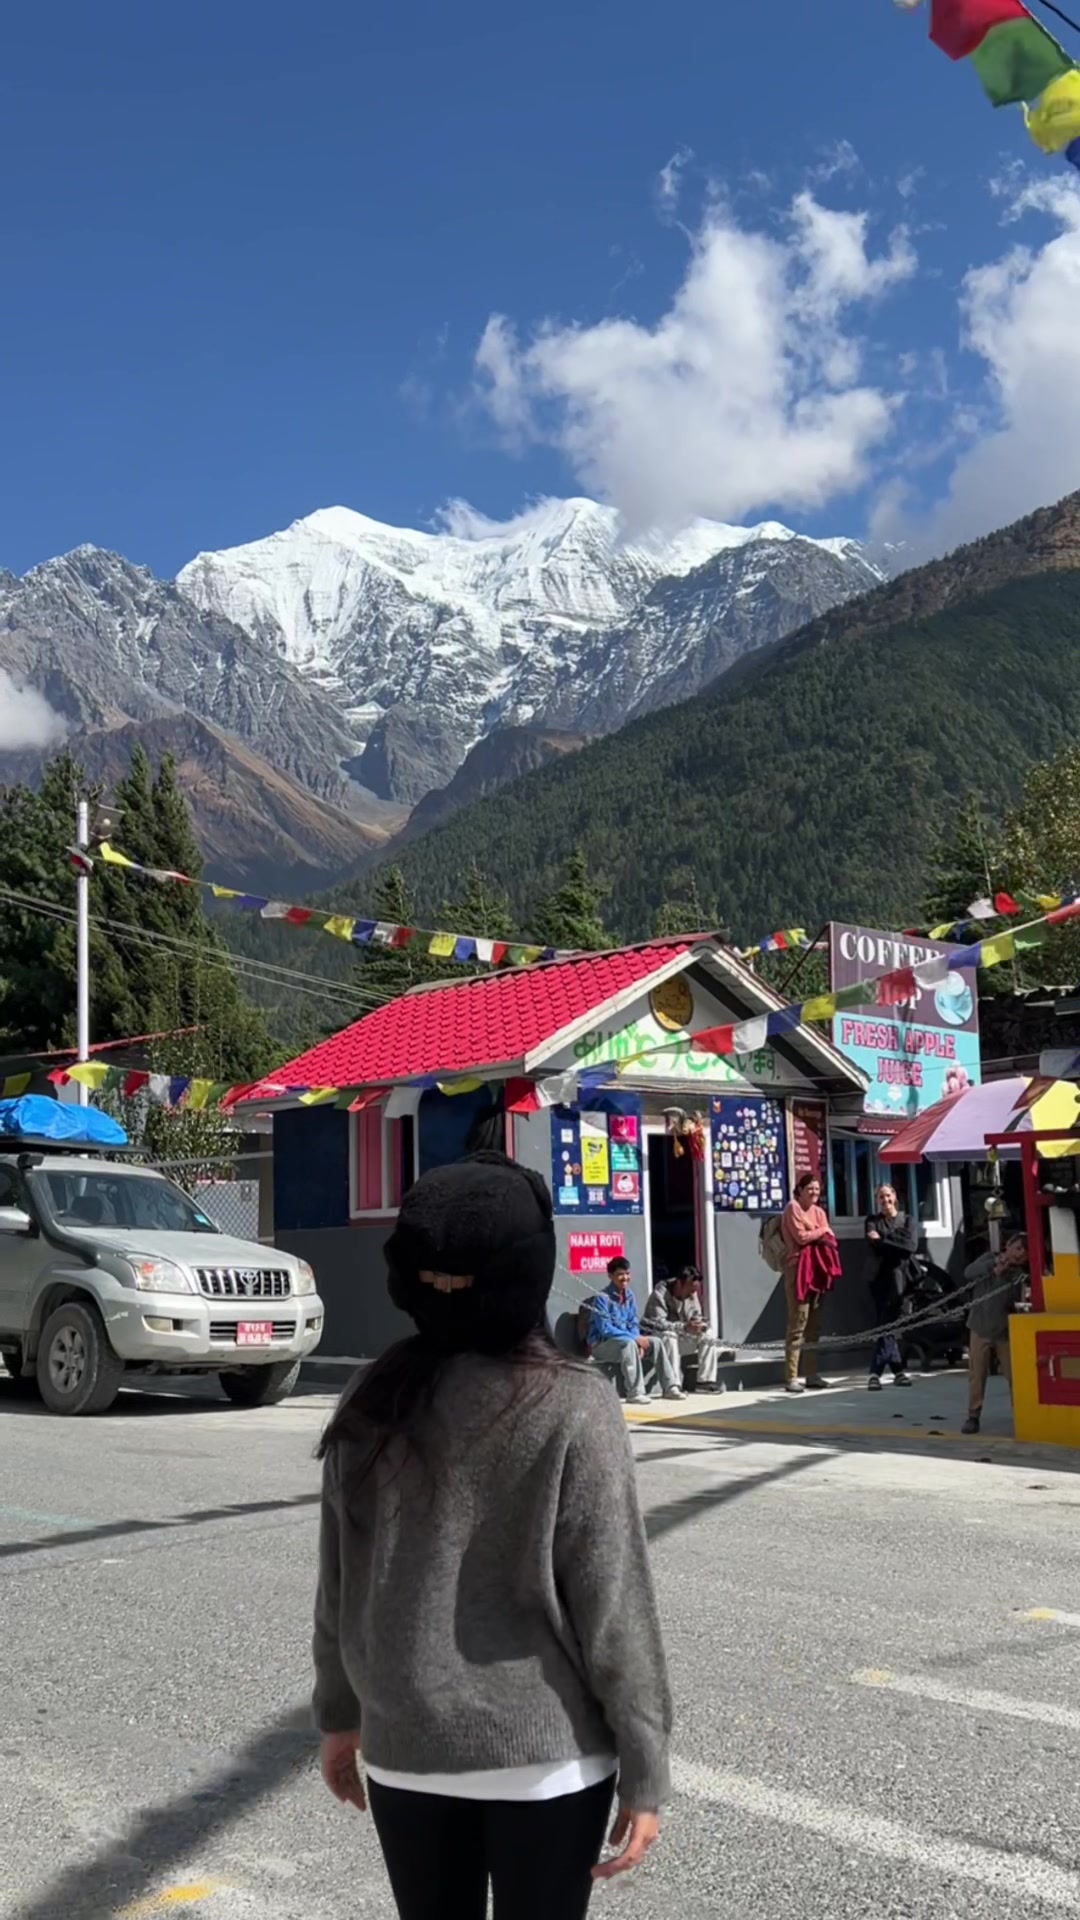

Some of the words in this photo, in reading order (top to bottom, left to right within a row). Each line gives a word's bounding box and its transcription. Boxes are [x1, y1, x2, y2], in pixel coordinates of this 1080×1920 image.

[841, 1018, 898, 1050] FRESH
[905, 1028, 956, 1060] APPLE
[877, 1057, 923, 1087] JUICE
[570, 1234, 598, 1247] NAAN
[599, 1234, 621, 1247] ROTI
